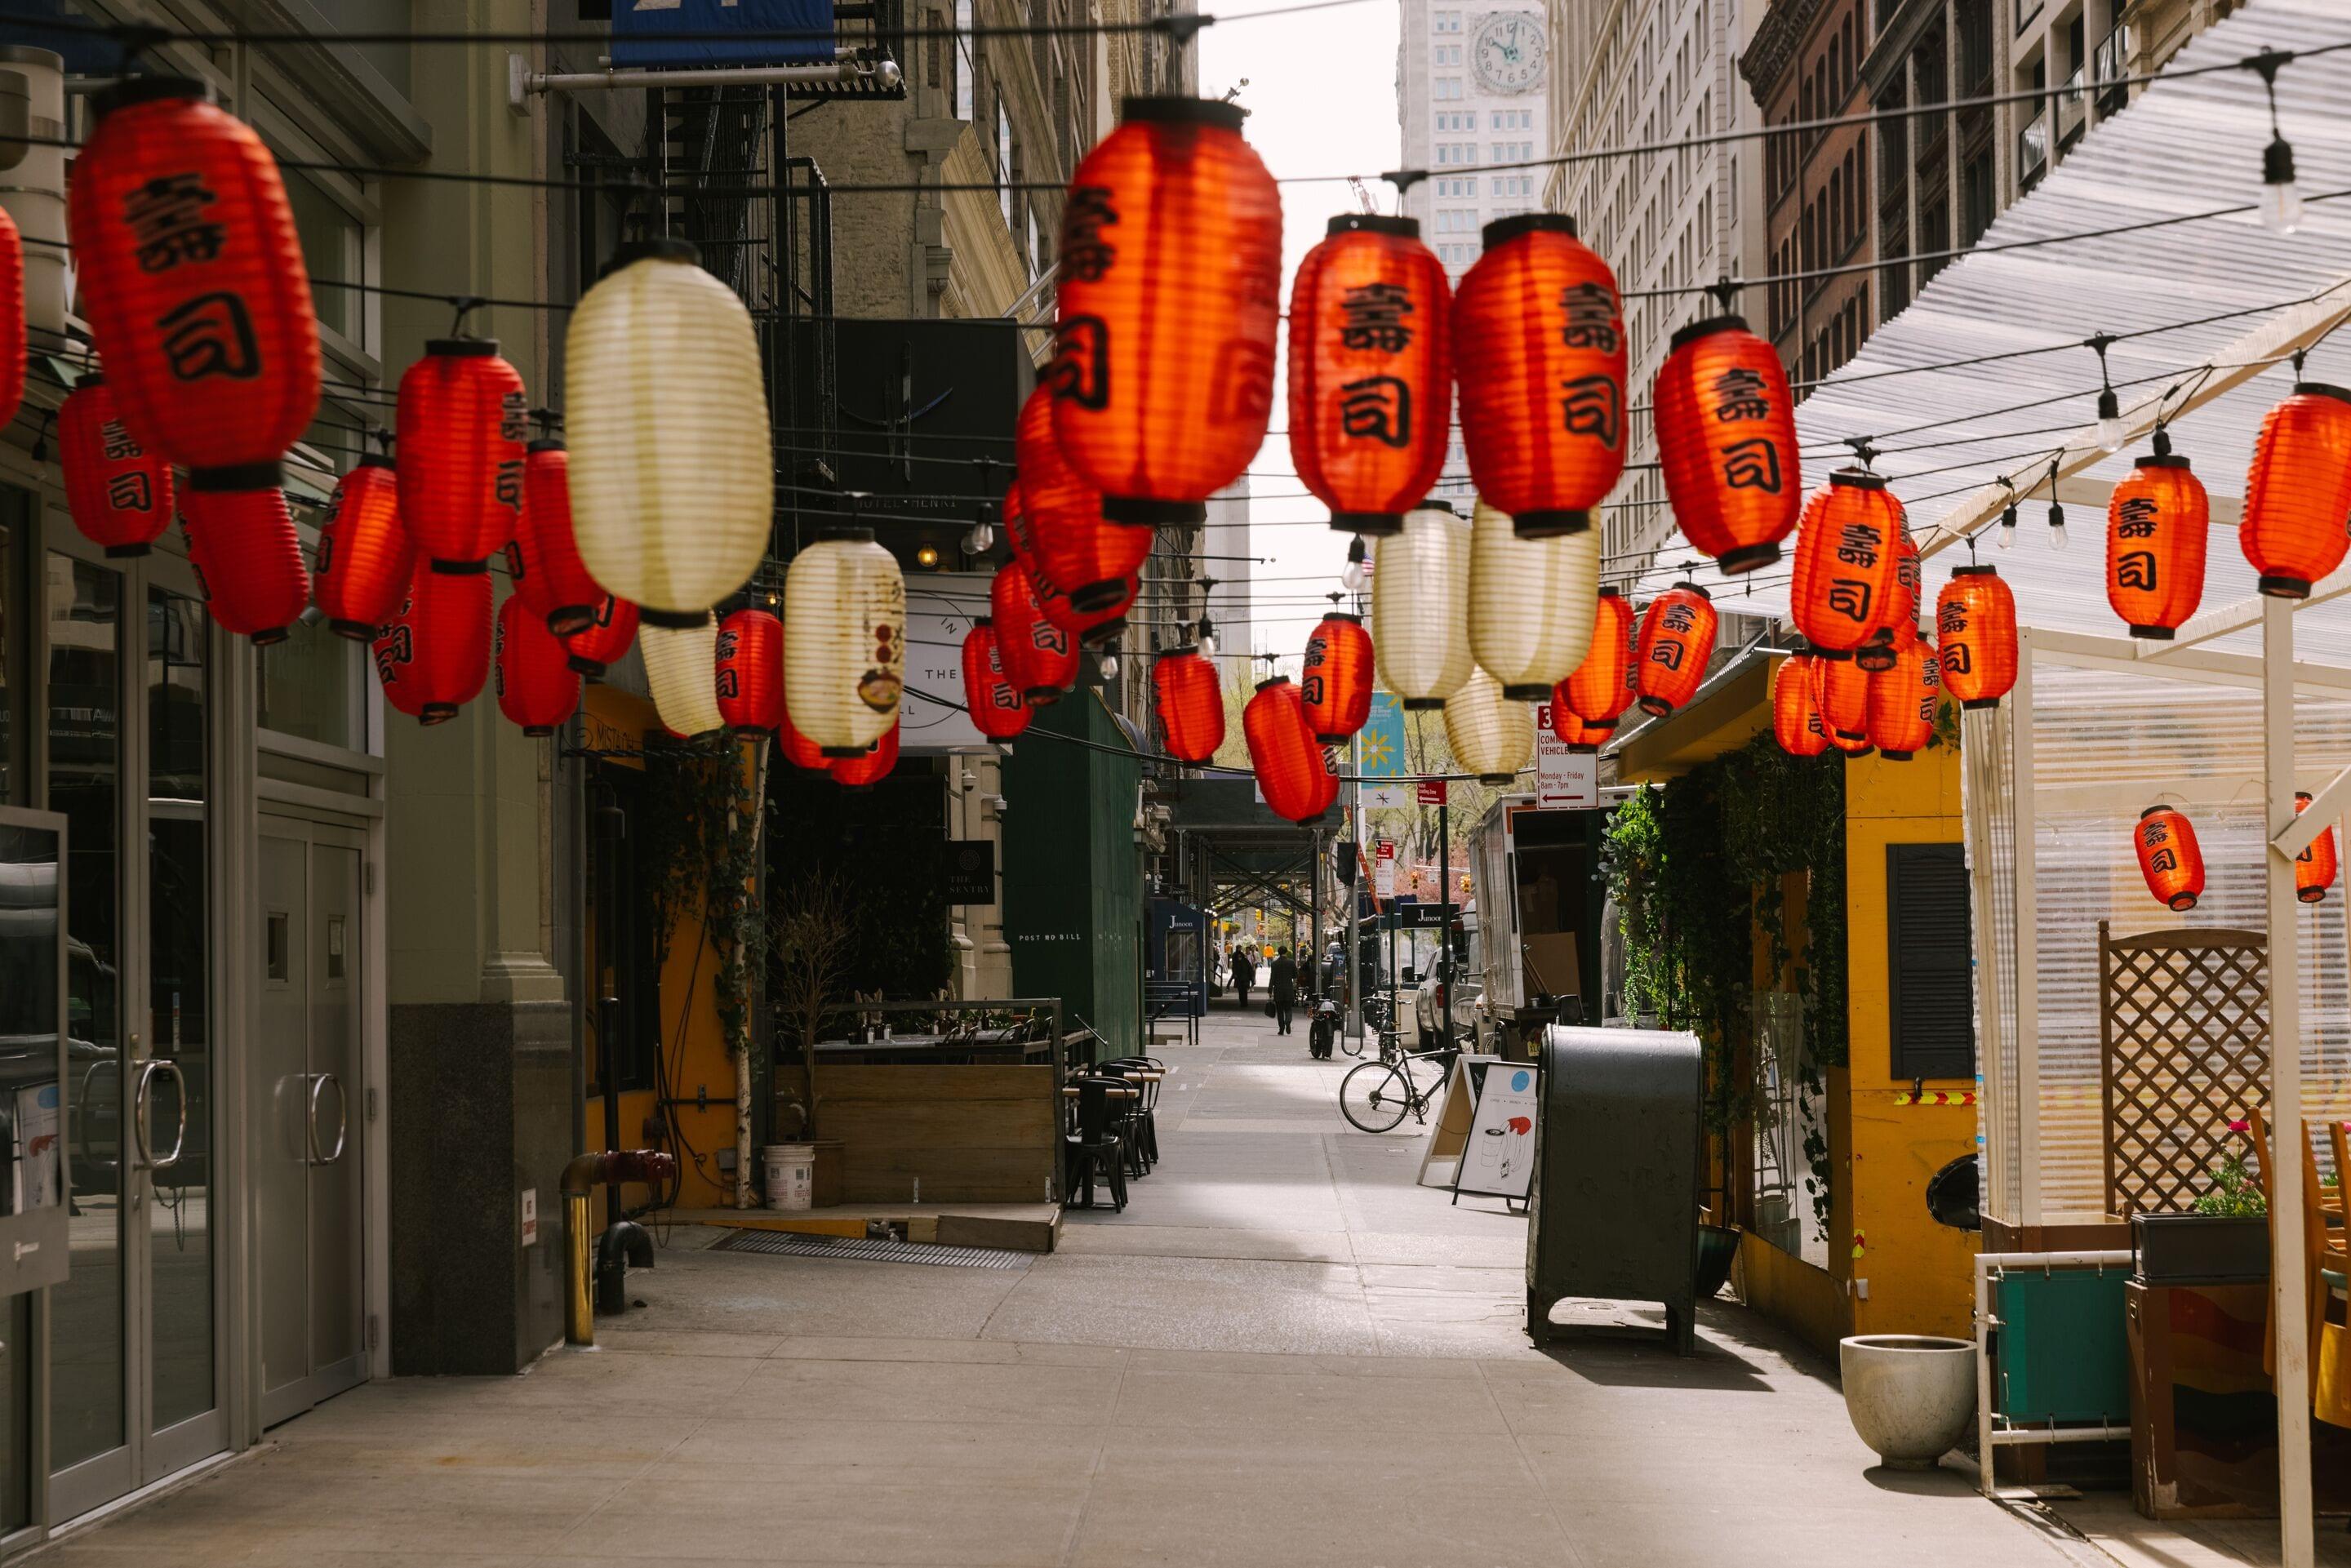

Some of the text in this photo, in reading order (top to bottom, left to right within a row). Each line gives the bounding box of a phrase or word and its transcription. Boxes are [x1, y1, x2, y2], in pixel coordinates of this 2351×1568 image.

[1495, 27, 1503, 37] 11
[1530, 34, 1536, 45] 2
[1482, 48, 1489, 58] 9
[1535, 47, 1542, 58] 3
[1485, 61, 1492, 71] 8
[1530, 60, 1536, 69] 4
[1495, 70, 1502, 80] 7
[1508, 73, 1515, 83] 6
[1521, 69, 1527, 80] 5
[940, 617, 958, 634] IN
[925, 669, 957, 679] THE
[1542, 708, 1553, 728] 3
[1540, 746, 1571, 755] VEHICLE
[1540, 772, 1562, 780] Monday
[1567, 771, 1584, 780] Friday
[1558, 781, 1569, 790] 7pm
[949, 886, 992, 894] SENTRY
[1169, 915, 1193, 929] Junoon
